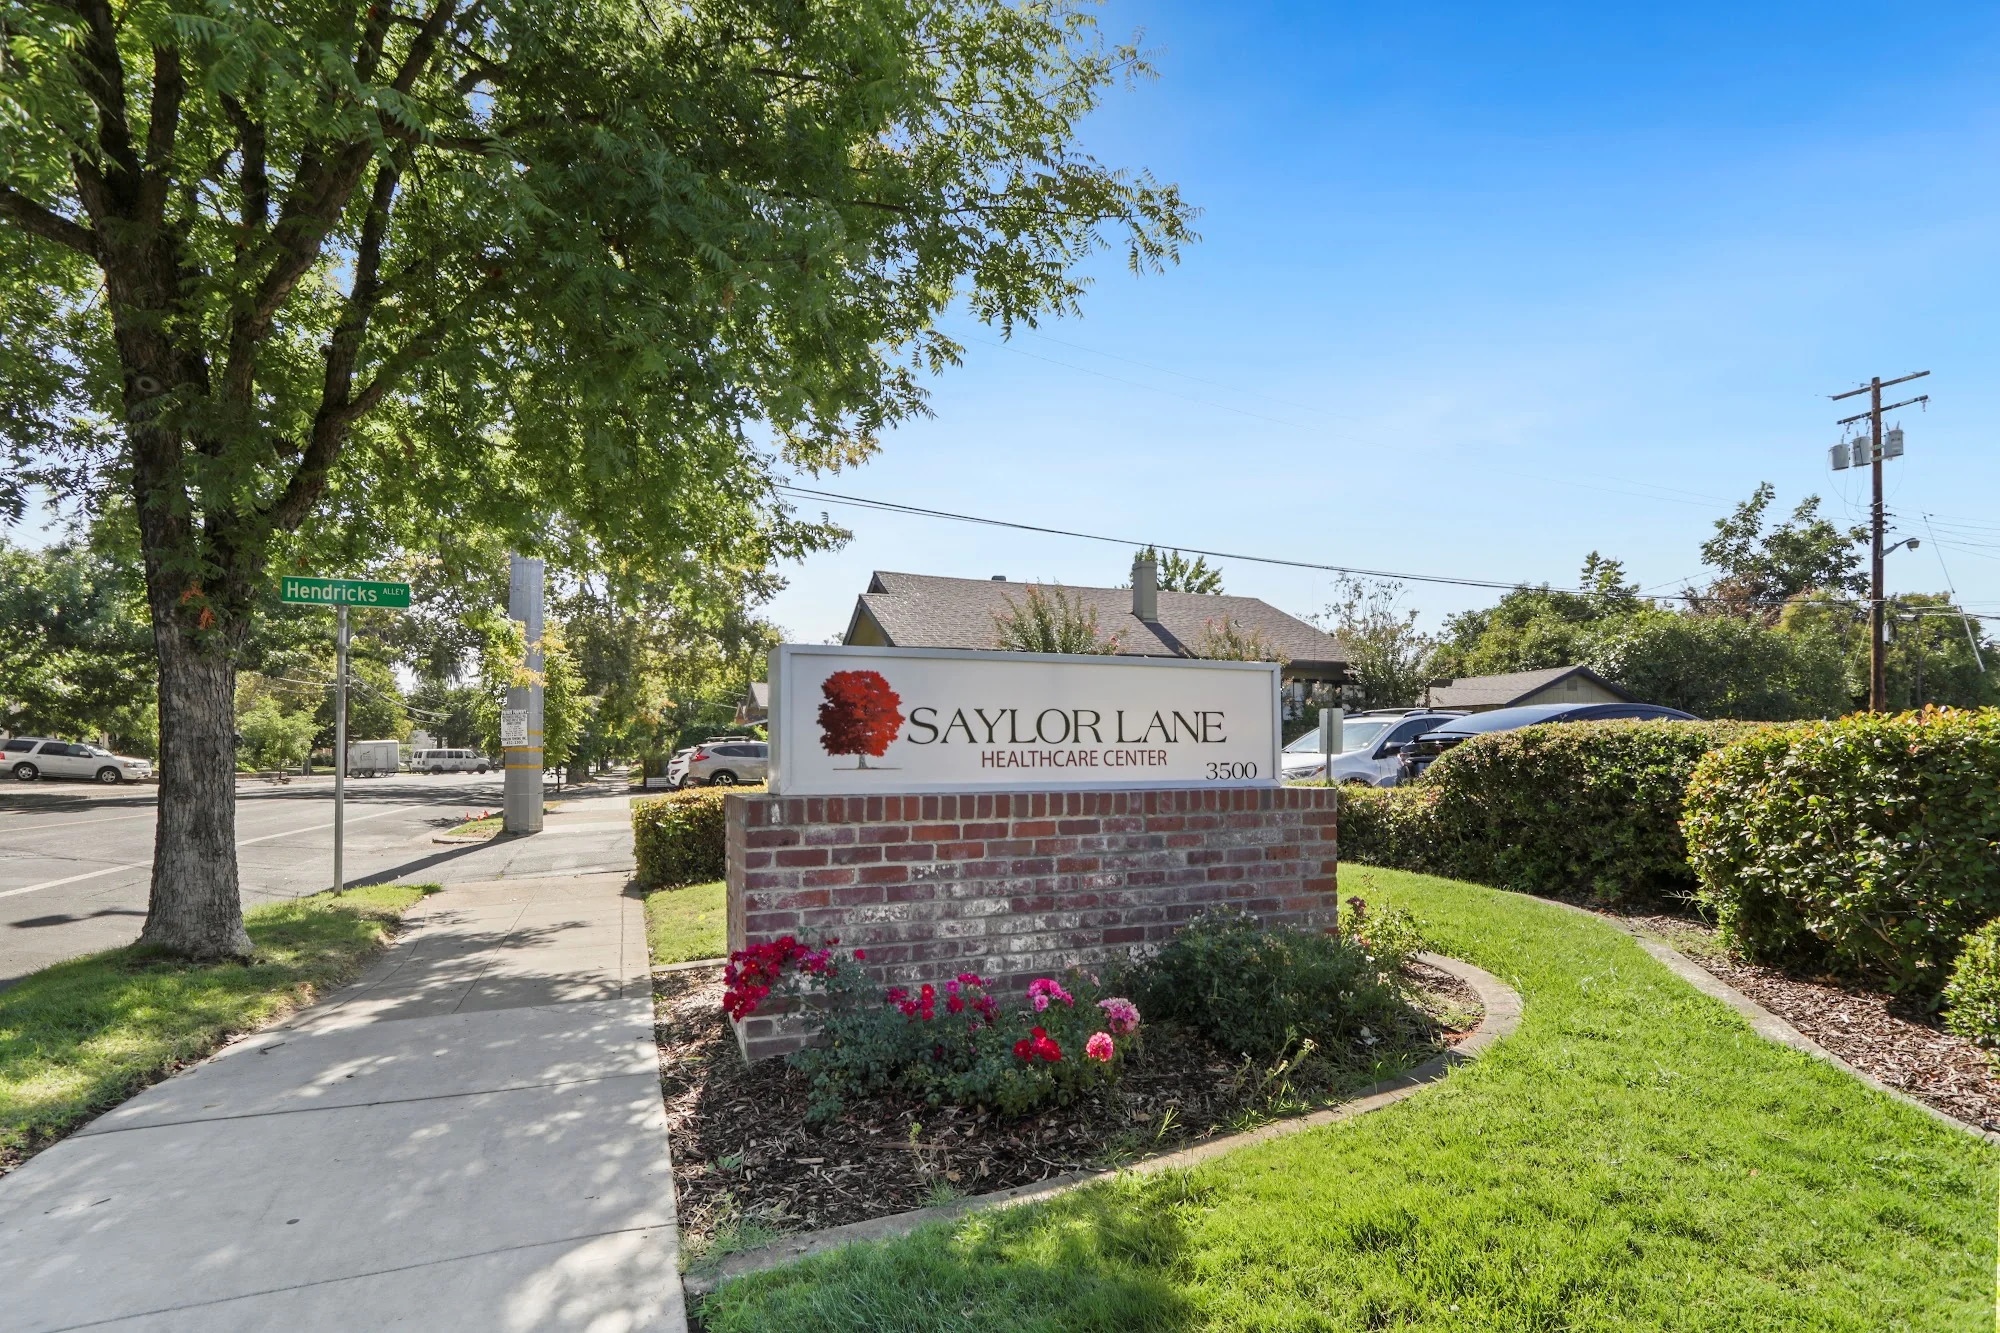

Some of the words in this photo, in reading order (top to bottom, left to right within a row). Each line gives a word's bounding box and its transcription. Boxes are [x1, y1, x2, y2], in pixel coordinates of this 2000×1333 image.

[287, 581, 377, 602] Hendricks
[382, 588, 404, 596] ALLEY
[907, 707, 1103, 744] SAYLOR
[1116, 710, 1227, 744] LANE
[982, 750, 1097, 768] HEALTHCARE
[1103, 750, 1167, 767] CENTER
[1205, 761, 1257, 780] 3500
